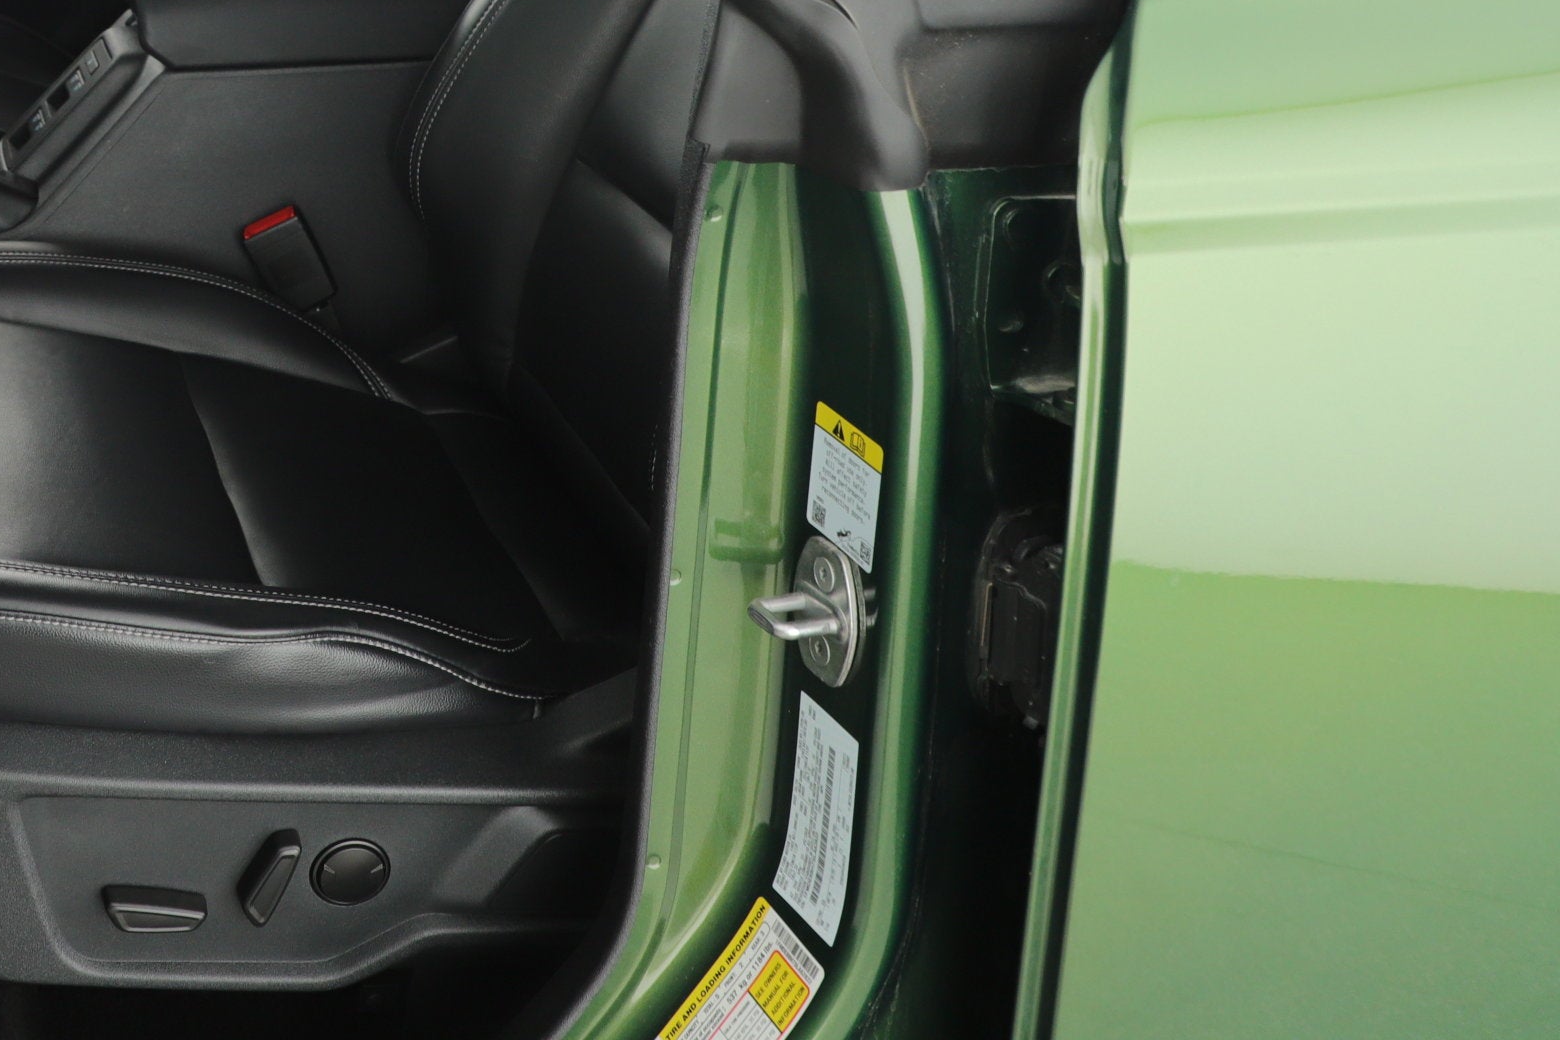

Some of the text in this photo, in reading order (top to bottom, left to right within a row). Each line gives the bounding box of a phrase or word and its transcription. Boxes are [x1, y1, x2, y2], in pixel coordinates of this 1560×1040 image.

[666, 1019, 682, 1040] TIRE
[683, 1002, 697, 1023] AND
[698, 966, 726, 1003] LOADING
[726, 905, 766, 965] INFORMATION
[726, 989, 738, 1005] 537
[750, 951, 766, 971] 1184
